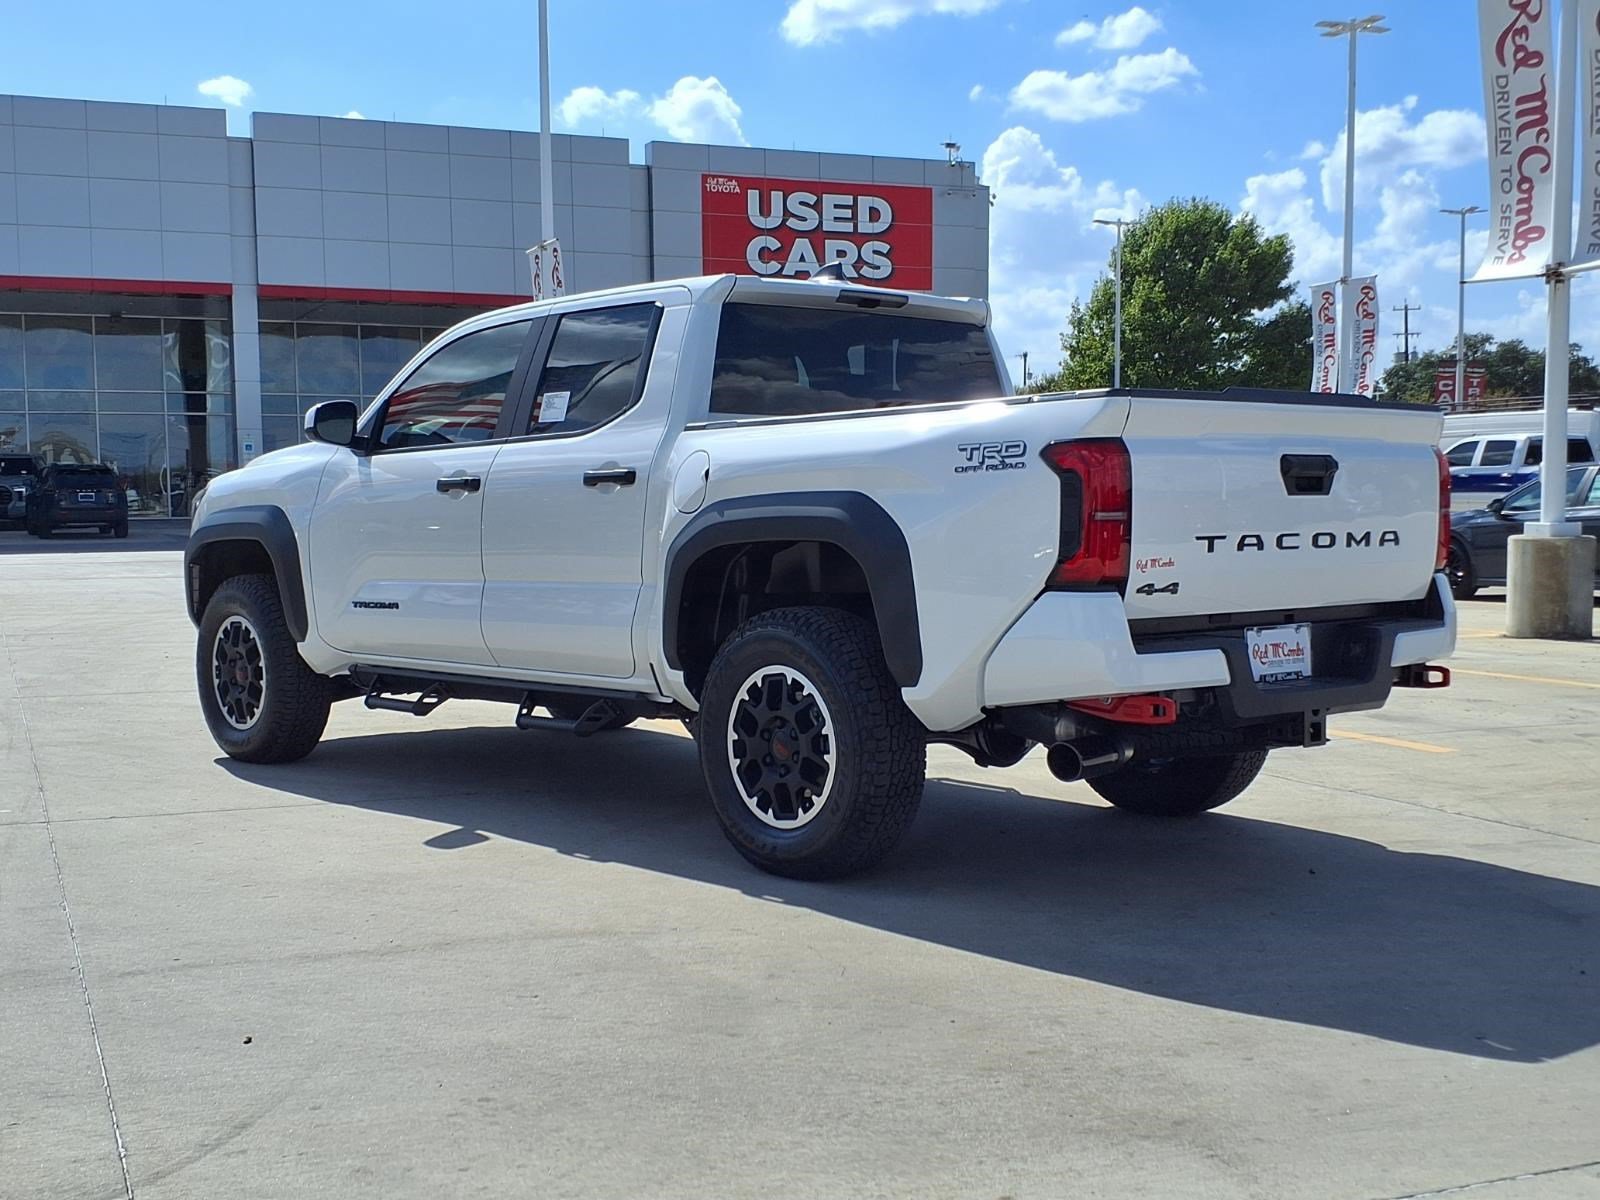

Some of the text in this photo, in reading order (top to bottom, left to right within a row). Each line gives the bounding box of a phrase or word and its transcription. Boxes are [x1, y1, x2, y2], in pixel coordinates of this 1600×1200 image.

[1492, 74, 1513, 266] DRIVEN TO SERVE
[1507, 73, 1551, 265] McCombs
[705, 183, 740, 194] TOYOTA
[747, 189, 893, 234] USED
[745, 235, 893, 279] CARS
[1318, 291, 1336, 393] Red McComb
[1356, 285, 1376, 394] Red McComb
[954, 461, 1026, 473] OFF ROAD
[958, 440, 1027, 464] TRD
[1195, 530, 1400, 553] TACOMA
[351, 600, 400, 610] TACOMA
[1252, 641, 1305, 665] Red McCombs
